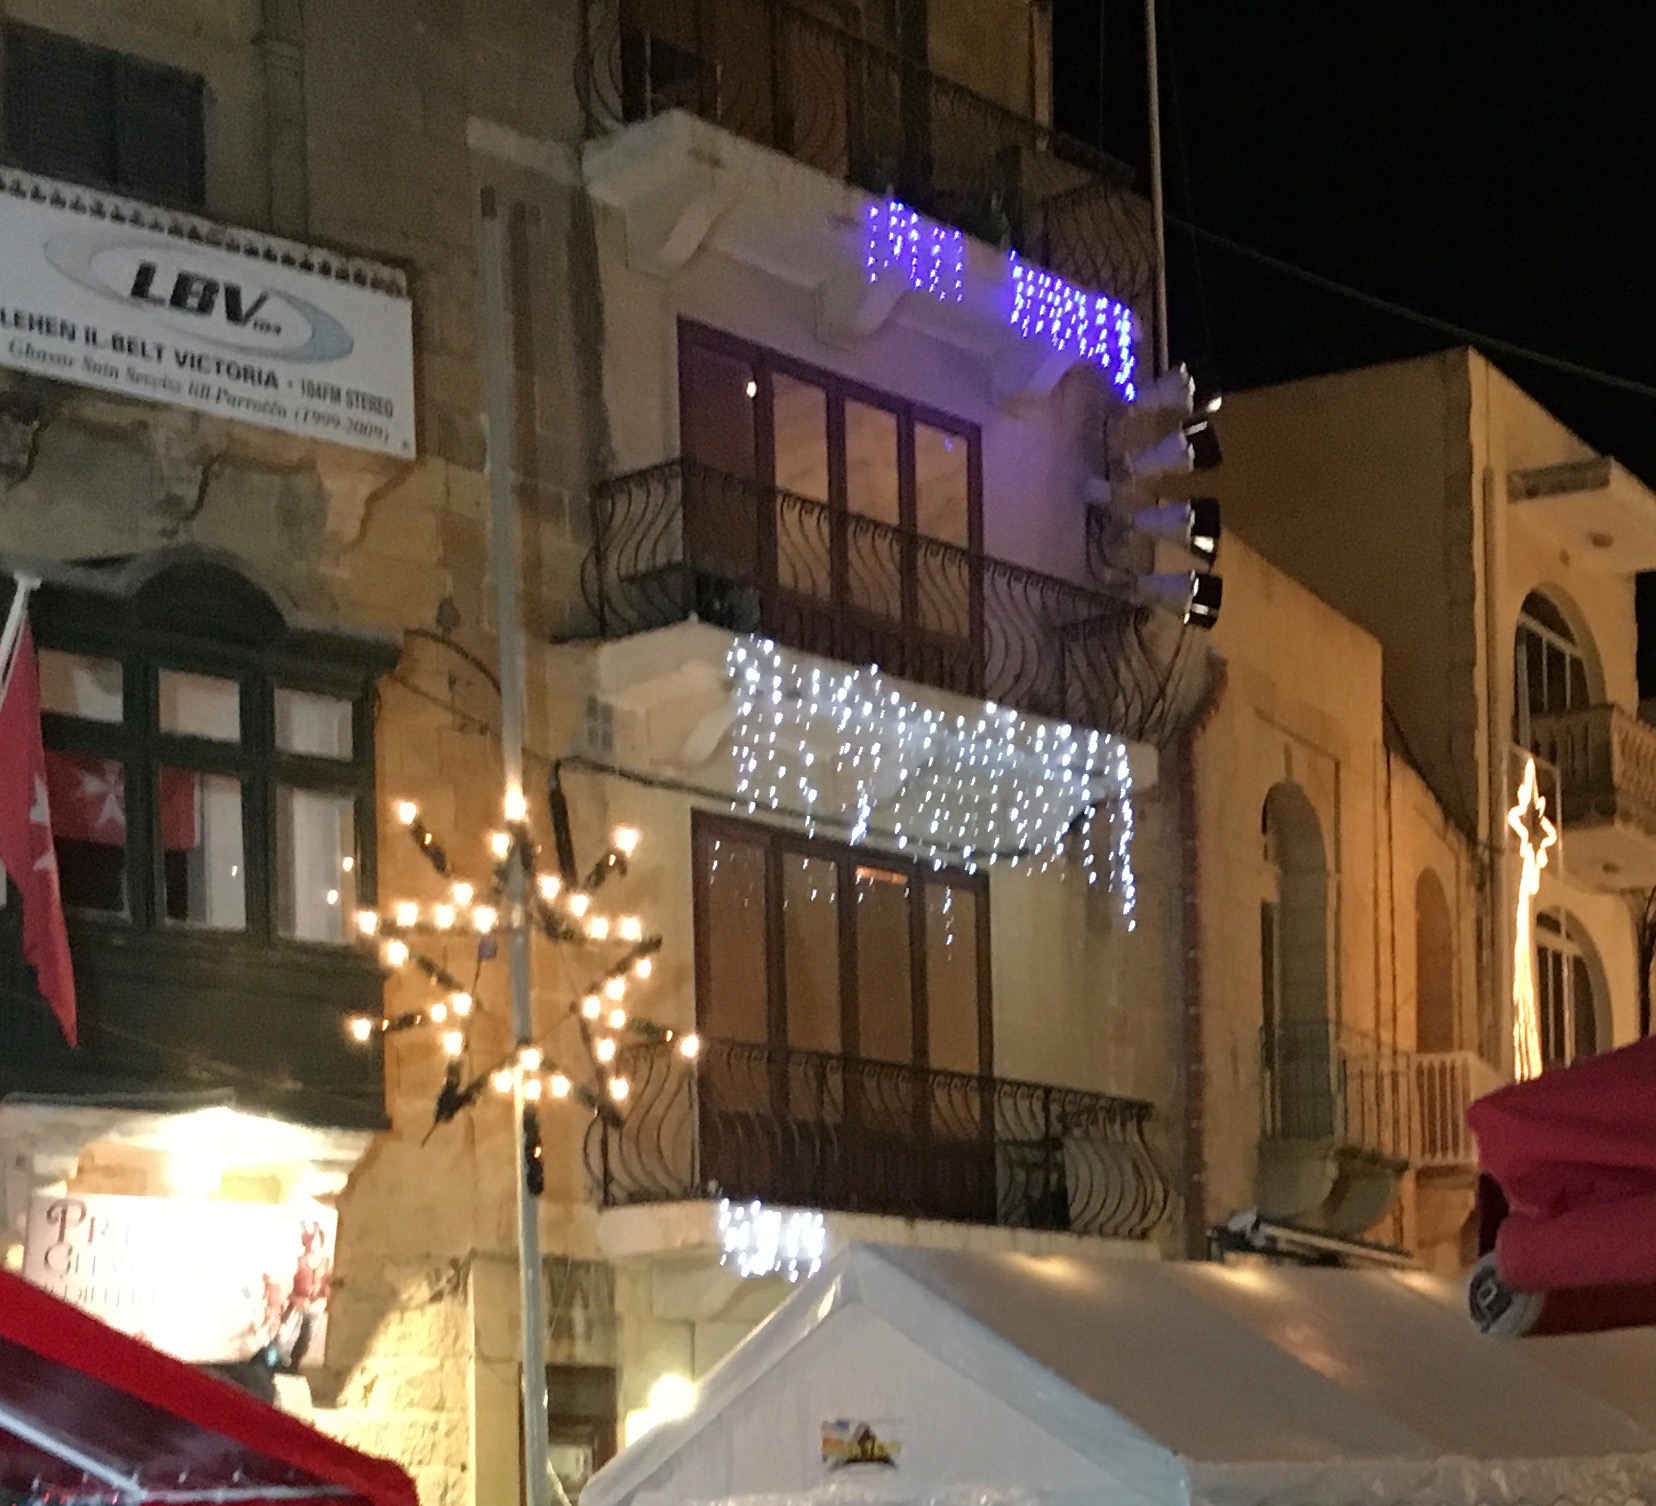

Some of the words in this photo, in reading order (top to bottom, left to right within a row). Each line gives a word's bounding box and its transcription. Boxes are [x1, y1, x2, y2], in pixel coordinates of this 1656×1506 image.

[129, 260, 271, 327] LBV
[84, 324, 166, 364] IL-BELT
[174, 346, 280, 391] VICTORIA
[300, 378, 342, 404] 104FM
[345, 386, 395, 420] STEREO
